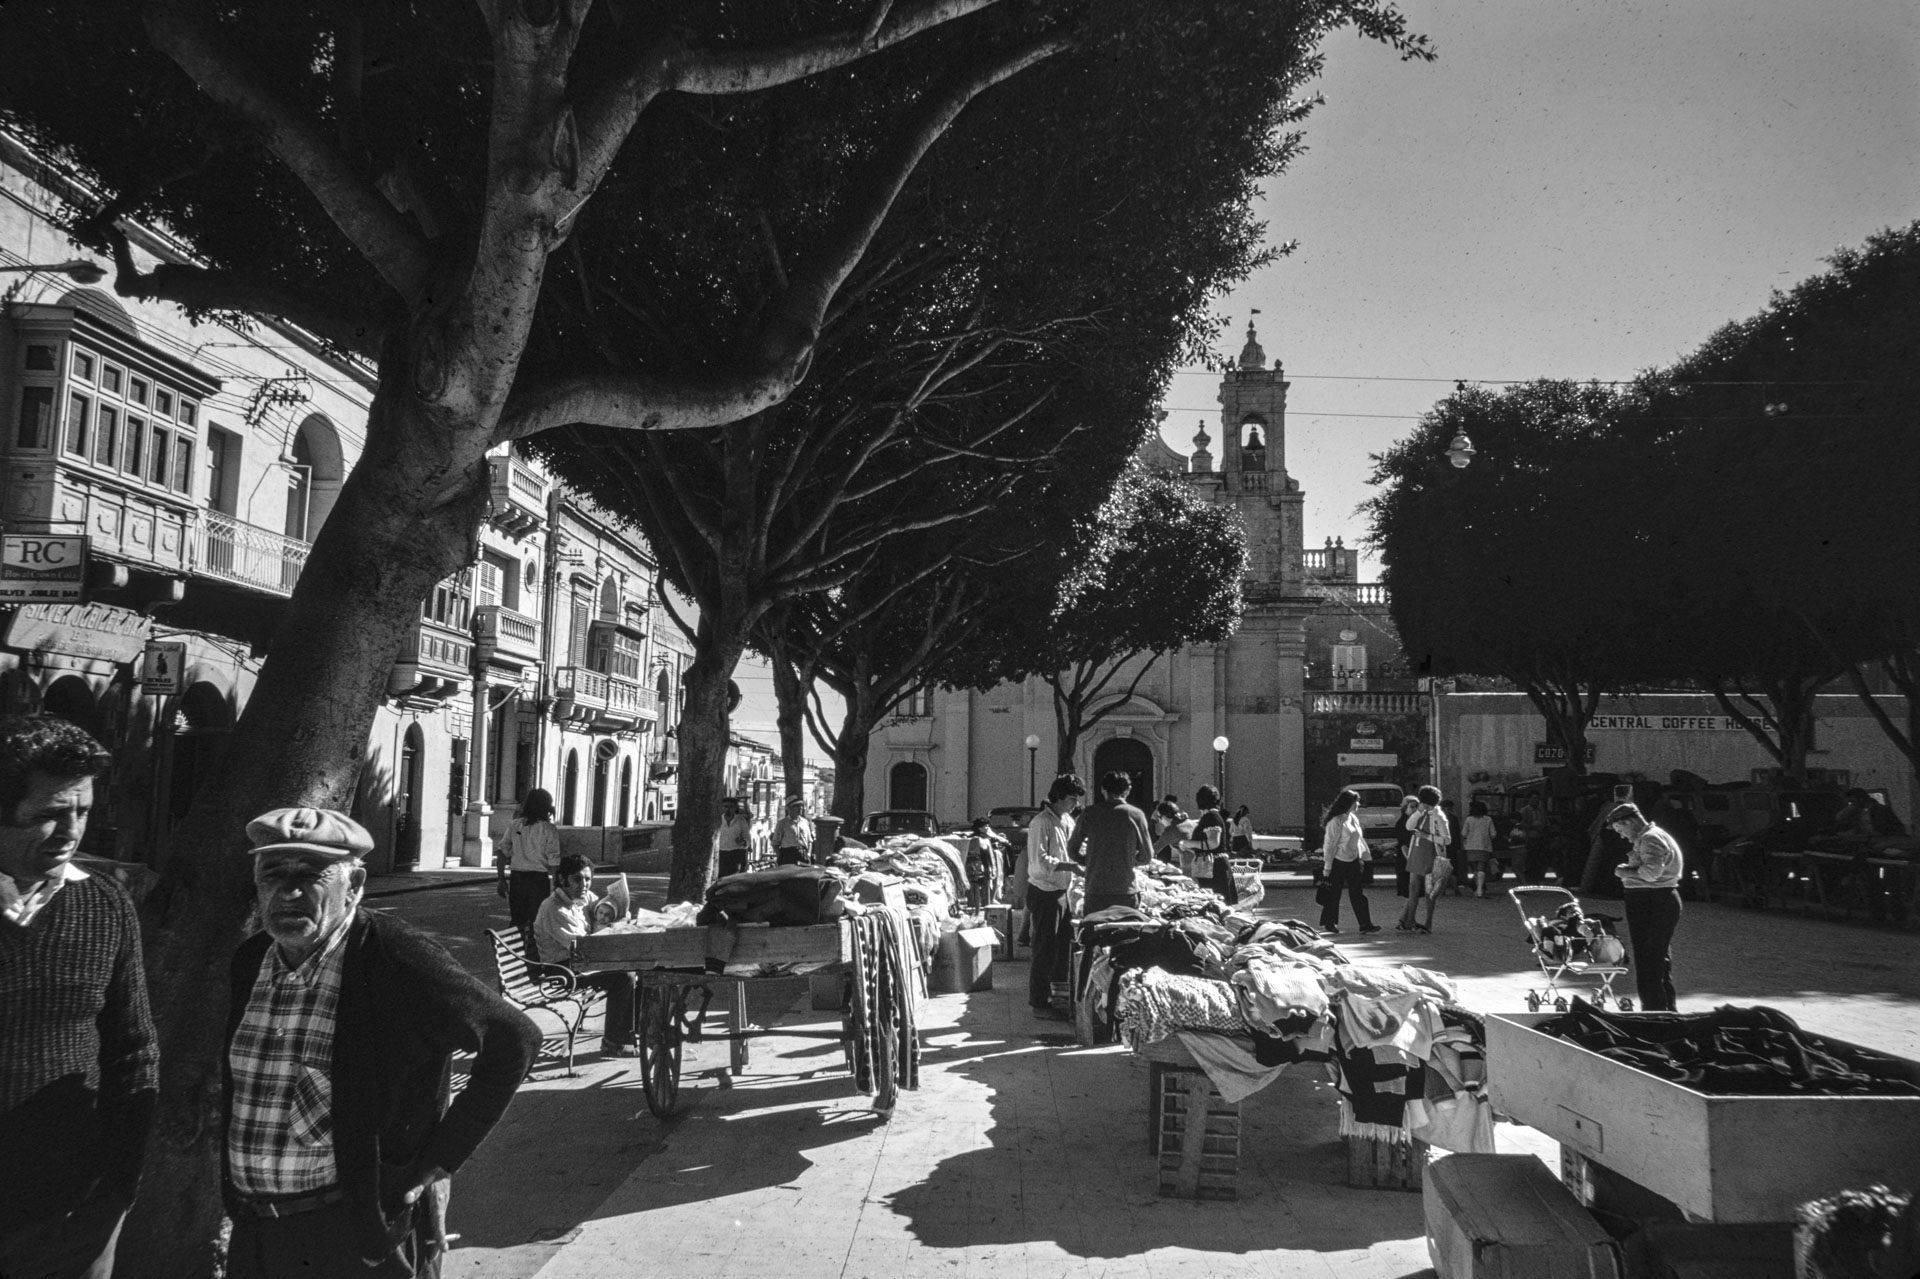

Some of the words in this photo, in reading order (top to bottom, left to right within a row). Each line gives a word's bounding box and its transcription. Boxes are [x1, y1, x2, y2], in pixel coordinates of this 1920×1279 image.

[19, 540, 66, 564] RC
[62, 590, 79, 598] BAR
[25, 603, 68, 625] SILVER
[71, 606, 121, 635] JUBILEE
[1591, 716, 1651, 729] CENTRAL
[1662, 717, 1715, 730] COFFEE
